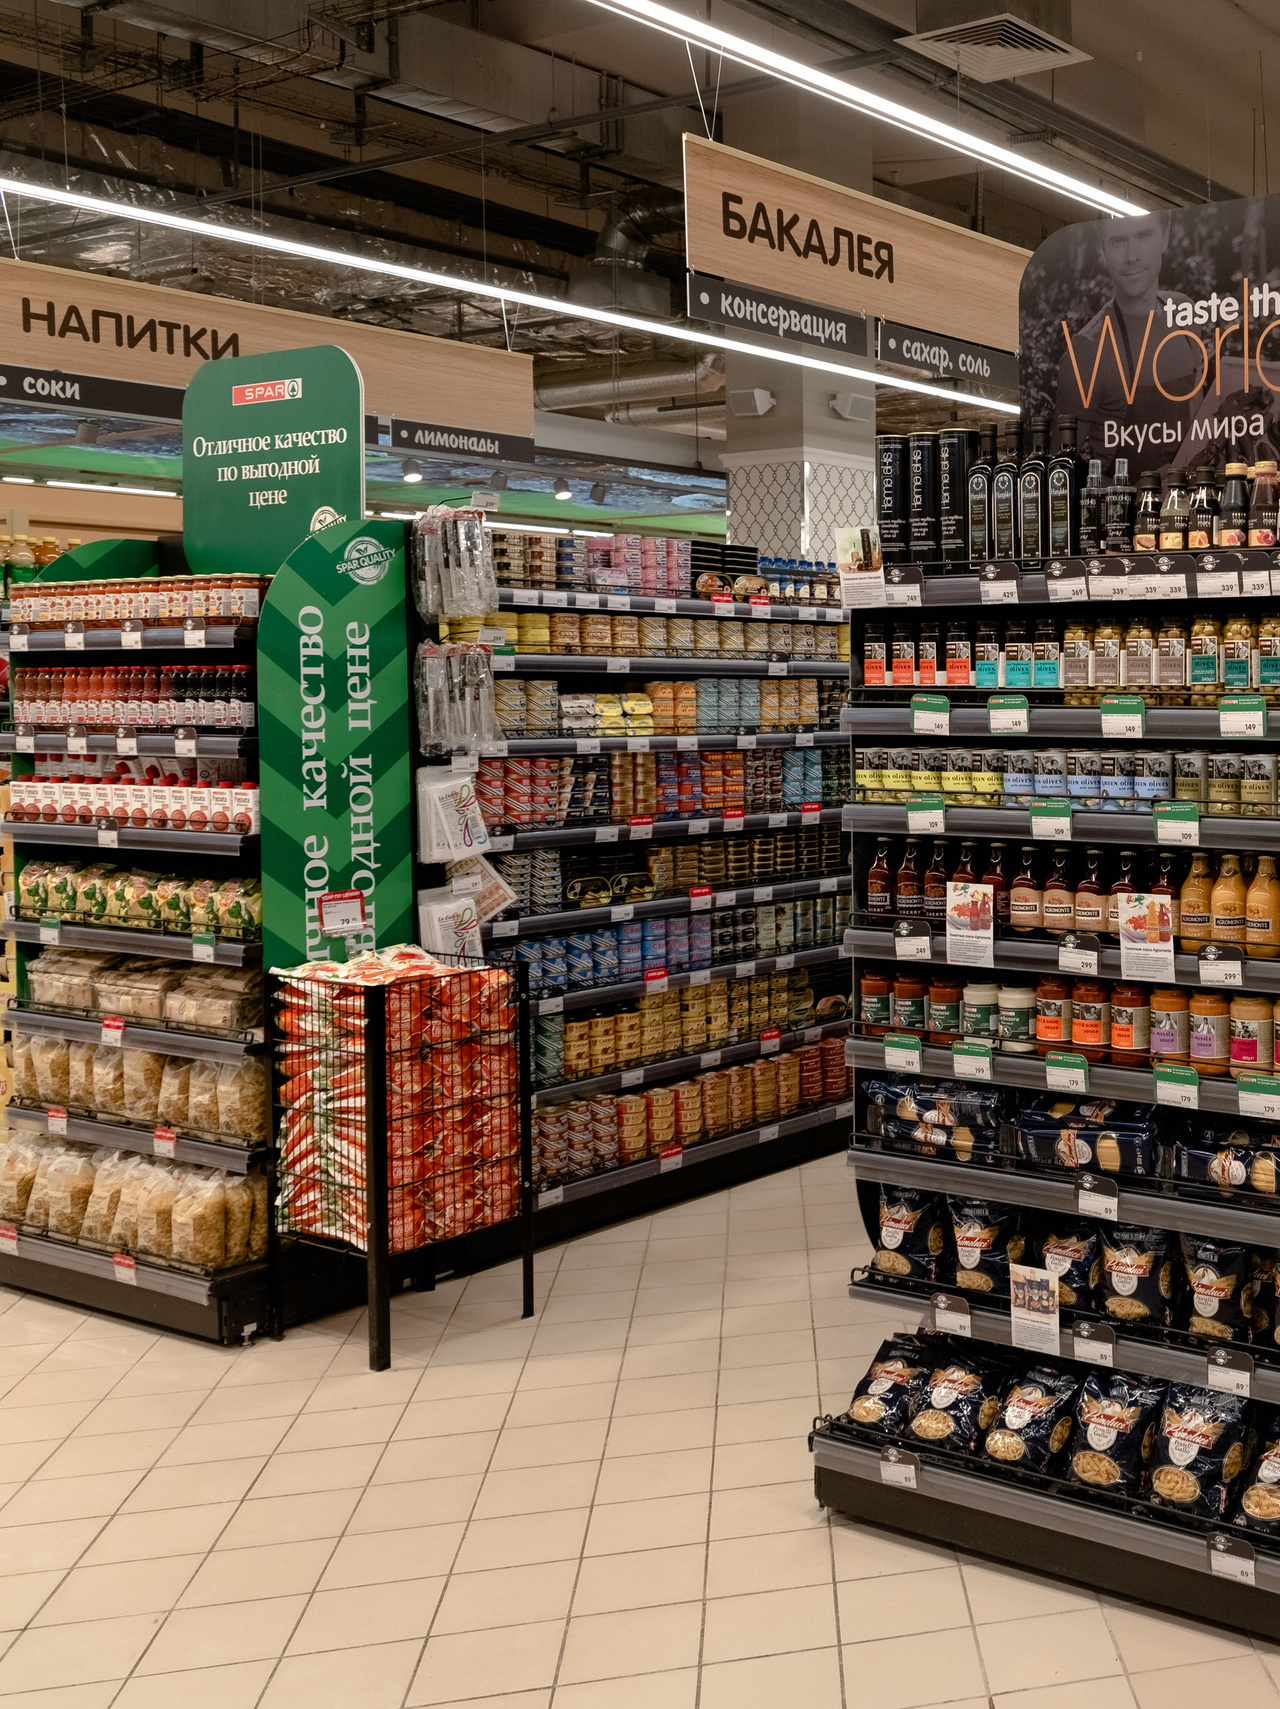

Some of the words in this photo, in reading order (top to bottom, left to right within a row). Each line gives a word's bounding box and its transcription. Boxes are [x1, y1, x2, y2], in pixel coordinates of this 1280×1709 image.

[721, 191, 895, 284] БАКАЛЕЯ
[720, 292, 848, 344] консервация
[1164, 292, 1240, 328] taste
[21, 296, 241, 362] НАПИТКИ
[902, 336, 954, 374] сахар,
[958, 352, 991, 378] соль
[22, 375, 81, 401] соки
[244, 382, 286, 400] SPAR
[193, 432, 271, 459] Отличное
[274, 426, 348, 450] качество
[414, 429, 500, 456] лимонады
[1103, 415, 1182, 453] Вкусы
[1190, 412, 1266, 446] мира
[217, 464, 239, 483] по
[241, 453, 321, 484] выгодной
[248, 486, 288, 510] цене
[336, 560, 360, 574] SPAR
[359, 548, 396, 567] QUALITY
[344, 621, 378, 732] цене
[298, 605, 328, 811] качество
[1125, 725, 1136, 733] 149
[1181, 832, 1192, 840] 109
[341, 753, 382, 954] ыодной
[340, 918, 350, 926] 79
[1081, 961, 1093, 969] 299
[1224, 972, 1237, 980] 299
[1106, 1259, 1147, 1276] Primeluci
